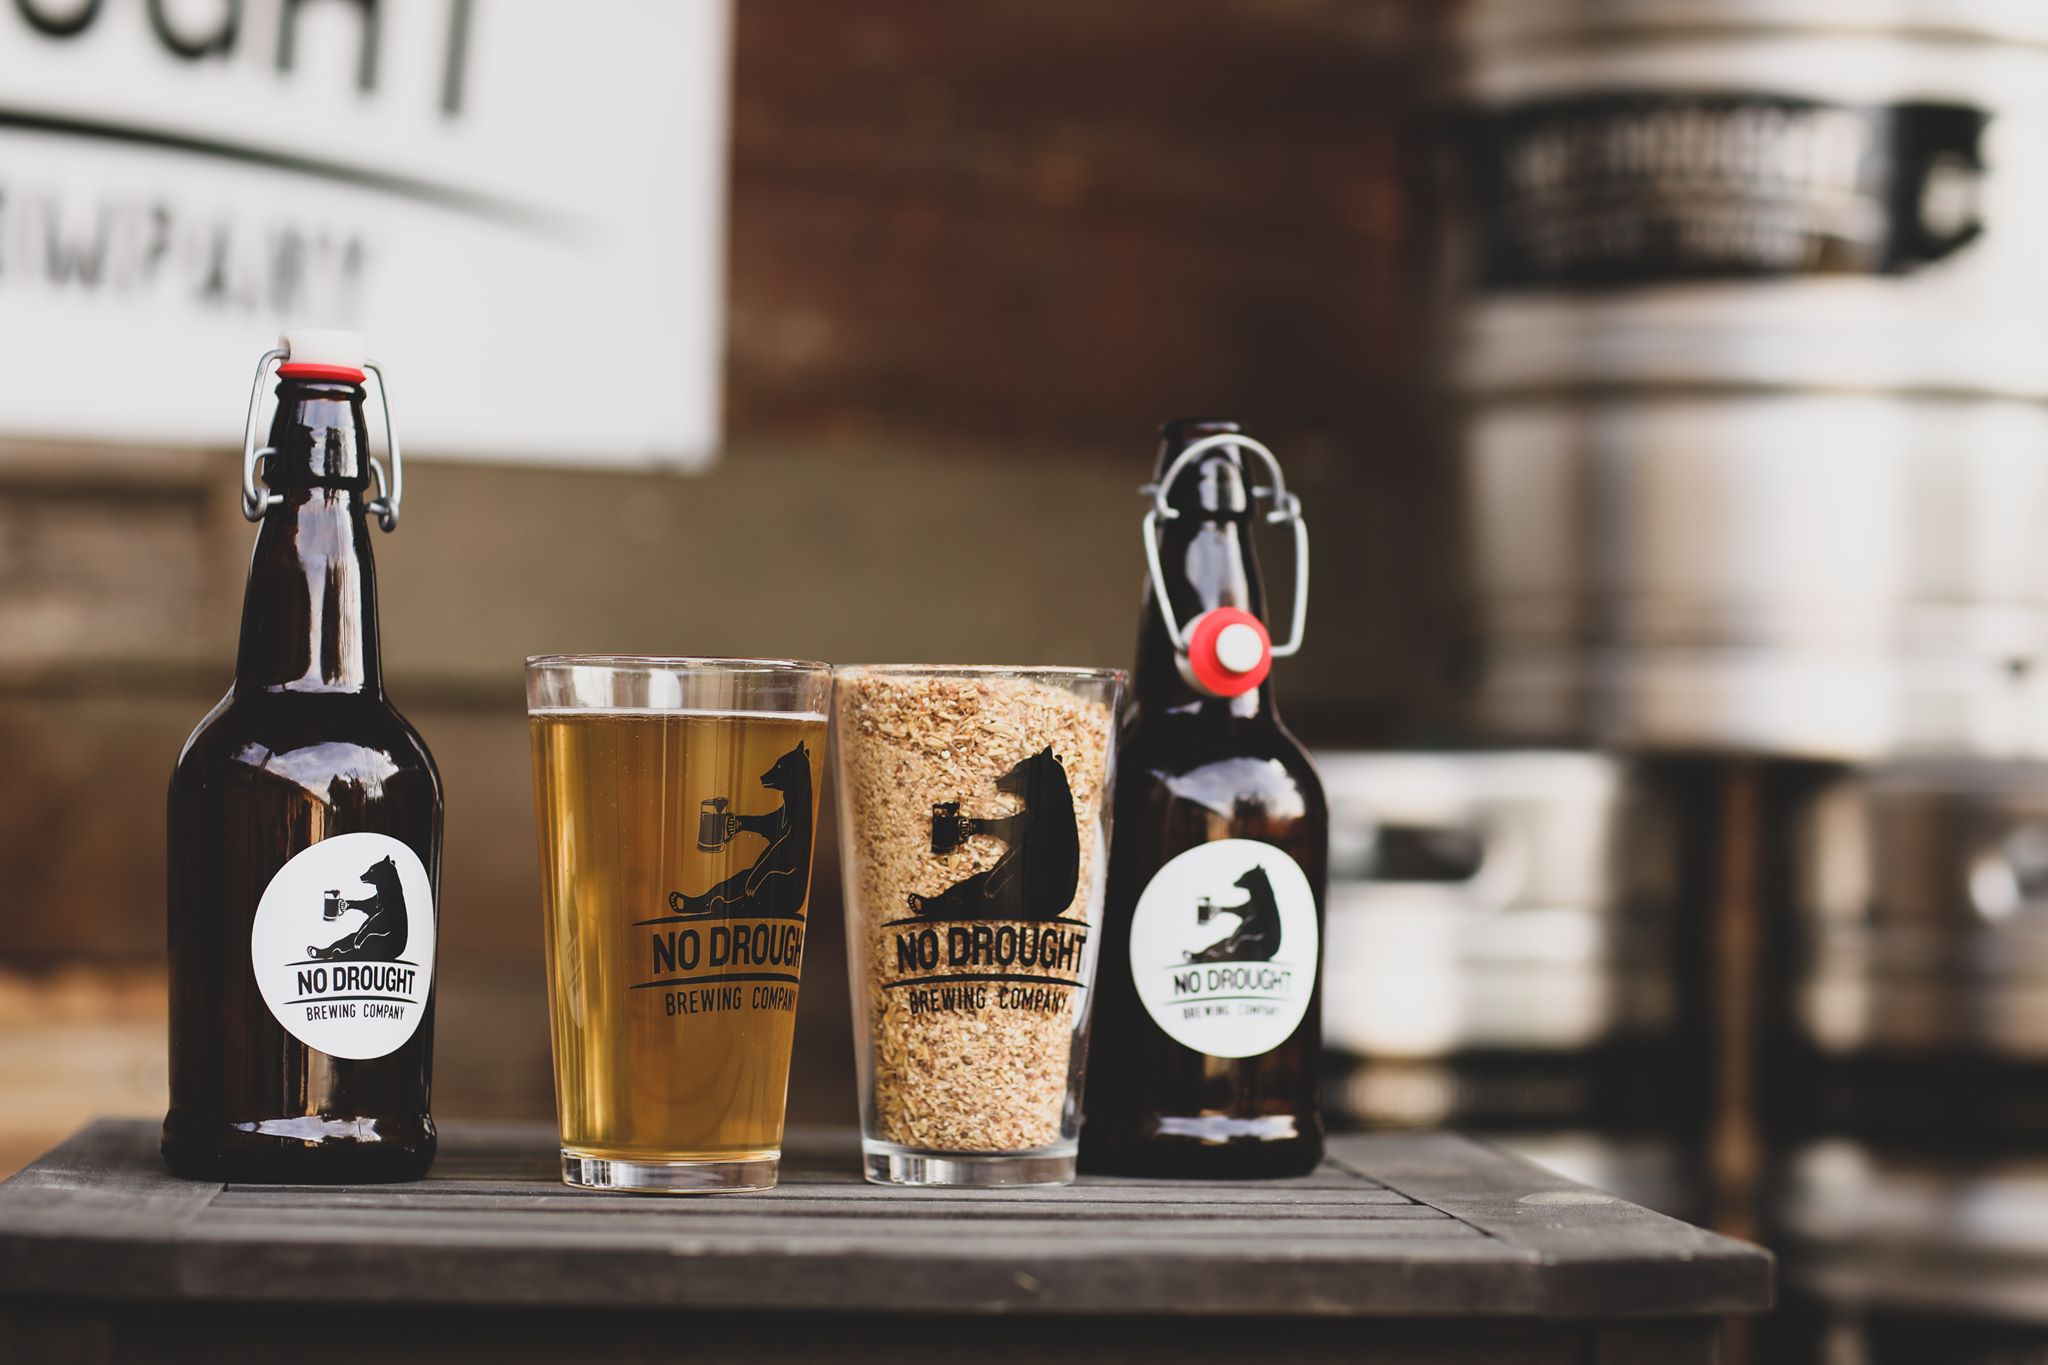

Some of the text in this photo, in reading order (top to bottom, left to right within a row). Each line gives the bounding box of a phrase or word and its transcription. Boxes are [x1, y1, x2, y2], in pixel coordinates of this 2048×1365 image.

[652, 928, 701, 974] NO
[896, 925, 1087, 974] NO DROUGHT
[297, 965, 416, 996] NO DROUGHT
[1174, 967, 1291, 996] NO DROUGHT
[306, 1003, 405, 1021] BREWING COMPANY
[665, 986, 742, 1017] BREWING
[909, 986, 1069, 1015] BREWING COMPANY
